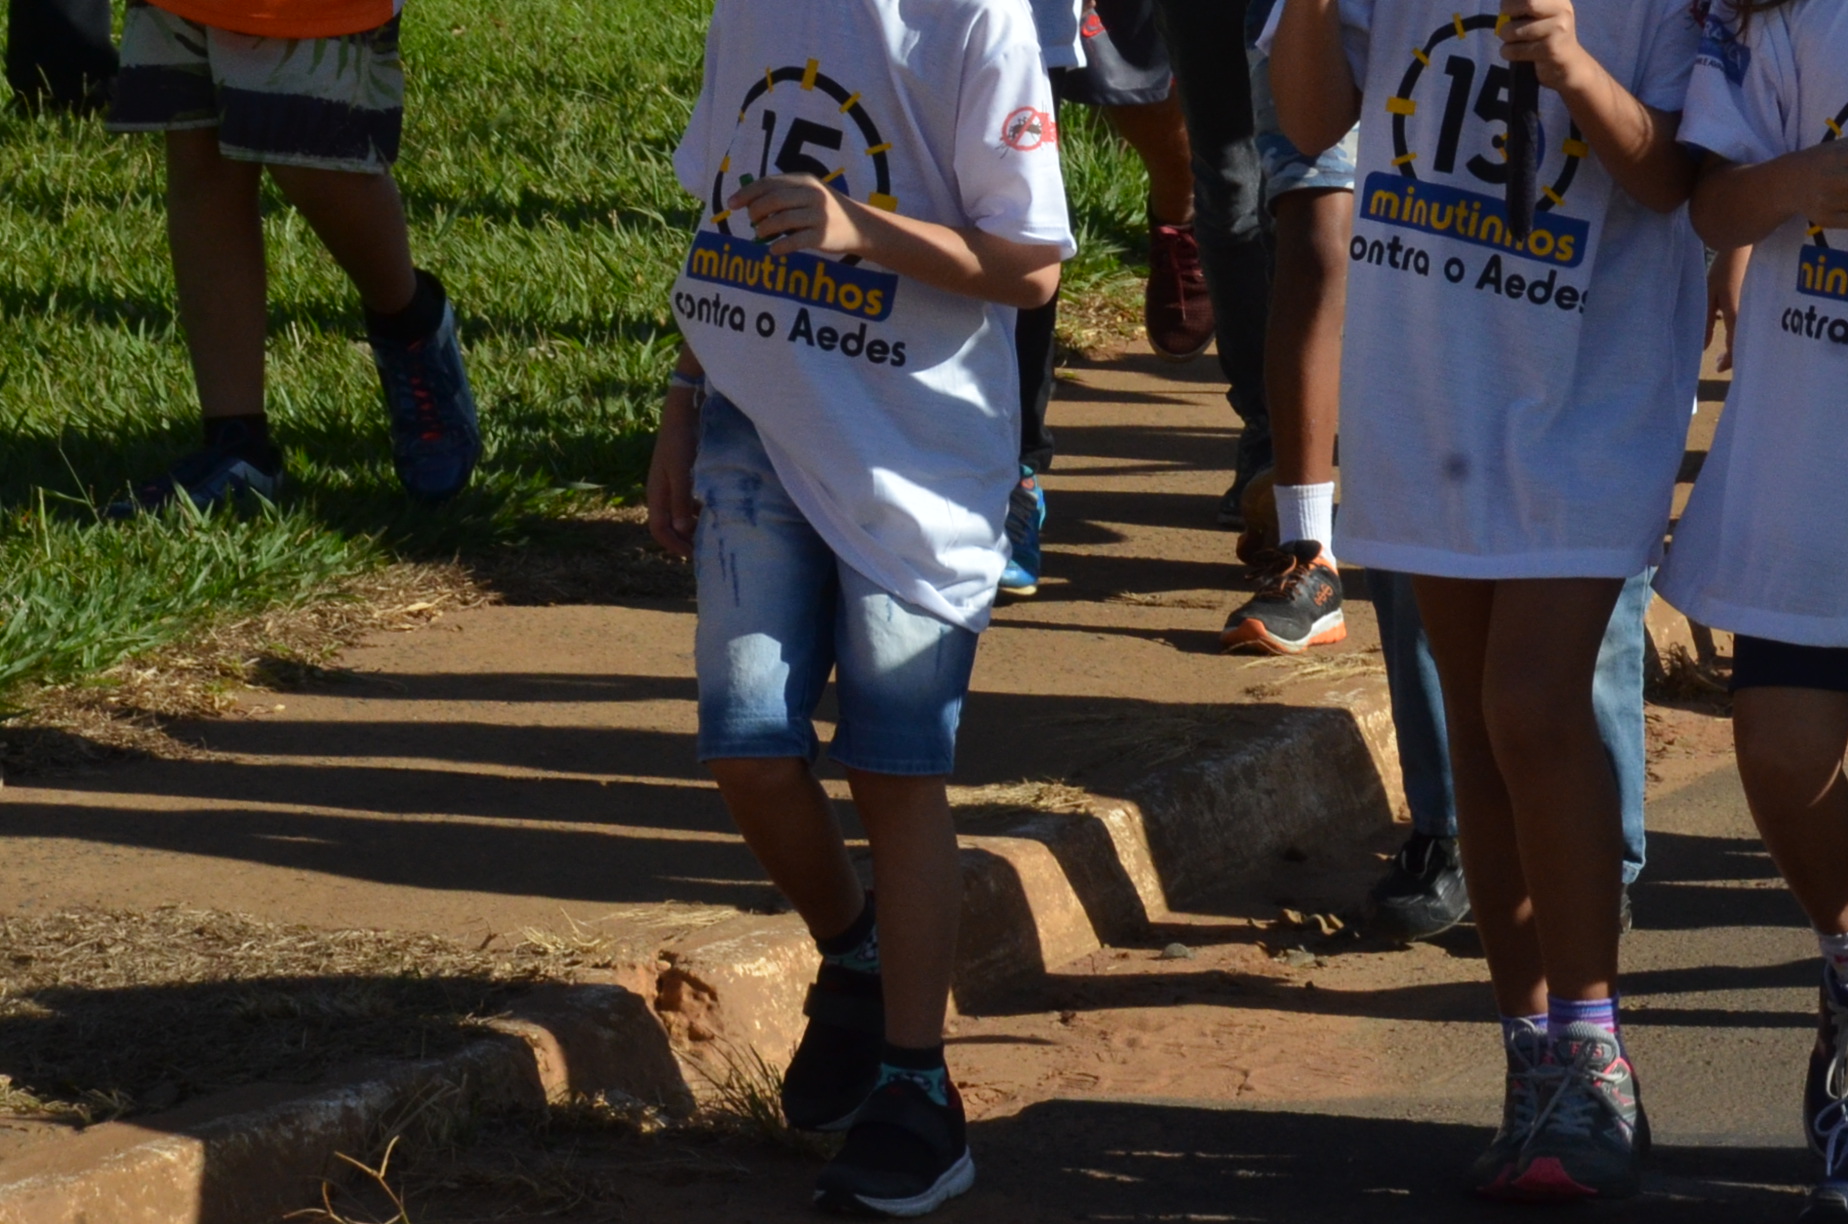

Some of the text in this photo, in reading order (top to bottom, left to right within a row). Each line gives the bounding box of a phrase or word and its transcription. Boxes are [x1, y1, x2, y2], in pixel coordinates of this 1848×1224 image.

[691, 243, 884, 316] minutinhos
[1444, 256, 1466, 284] o
[755, 310, 776, 338] o
[787, 306, 907, 368] Aedes
